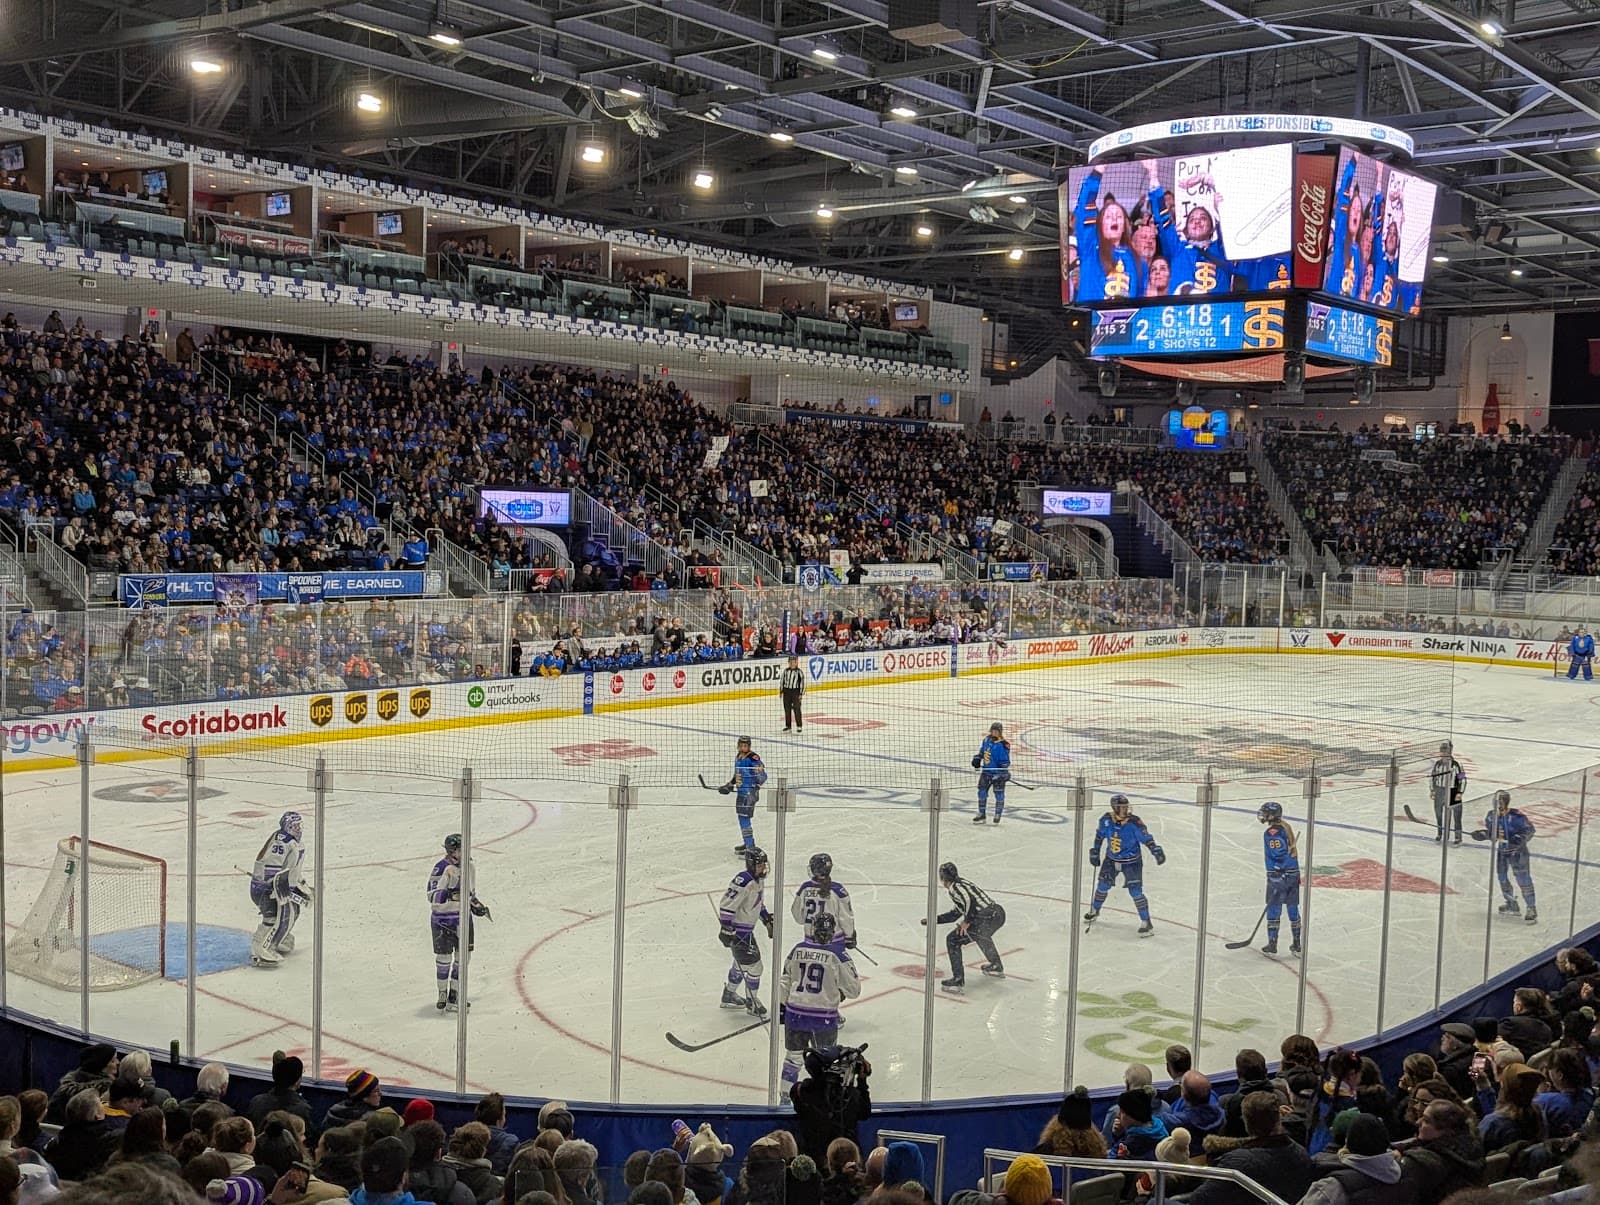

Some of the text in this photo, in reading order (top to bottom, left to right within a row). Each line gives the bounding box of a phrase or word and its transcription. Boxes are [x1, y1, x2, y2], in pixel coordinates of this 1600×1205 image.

[1170, 118, 1210, 134] PLEASE
[1213, 117, 1241, 131] PLAY
[1297, 180, 1326, 263] Coca-Cola
[38, 251, 64, 260] GRAHAM
[114, 261, 137, 272] THOMAS
[1162, 304, 1212, 328] 6:18
[1342, 310, 1364, 335] 6:18
[1136, 320, 1149, 341] 2
[1155, 327, 1212, 339] 2ND Period
[1220, 314, 1231, 337] 1
[1329, 319, 1336, 340] 2
[1163, 338, 1199, 349] SHOTS
[1204, 337, 1216, 347] 12
[1367, 328, 1372, 349] 1
[346, 578, 404, 589] EARNED.
[1027, 640, 1079, 658] pizza pizza
[1088, 634, 1134, 656] Molson
[1144, 635, 1177, 646] AEROPLAN
[1348, 637, 1414, 648] CANADIAN TIRE
[1422, 638, 1465, 651] Shark
[1470, 640, 1506, 656] NINJA
[900, 651, 947, 669] ROGERS
[1515, 643, 1541, 660] Tim
[828, 658, 878, 674] FANDUEL
[702, 664, 780, 687] GATORADE
[488, 684, 514, 693] INTUIT
[378, 699, 398, 717] ups
[411, 696, 430, 714] ups
[487, 692, 540, 709] quickbooks
[311, 704, 332, 722] ups
[346, 701, 366, 720] ups
[141, 704, 287, 741] Scotiabank
[271, 845, 284, 854] 35
[805, 900, 826, 923] 21
[797, 951, 829, 963] FLAHERTY
[796, 962, 825, 994] 19
